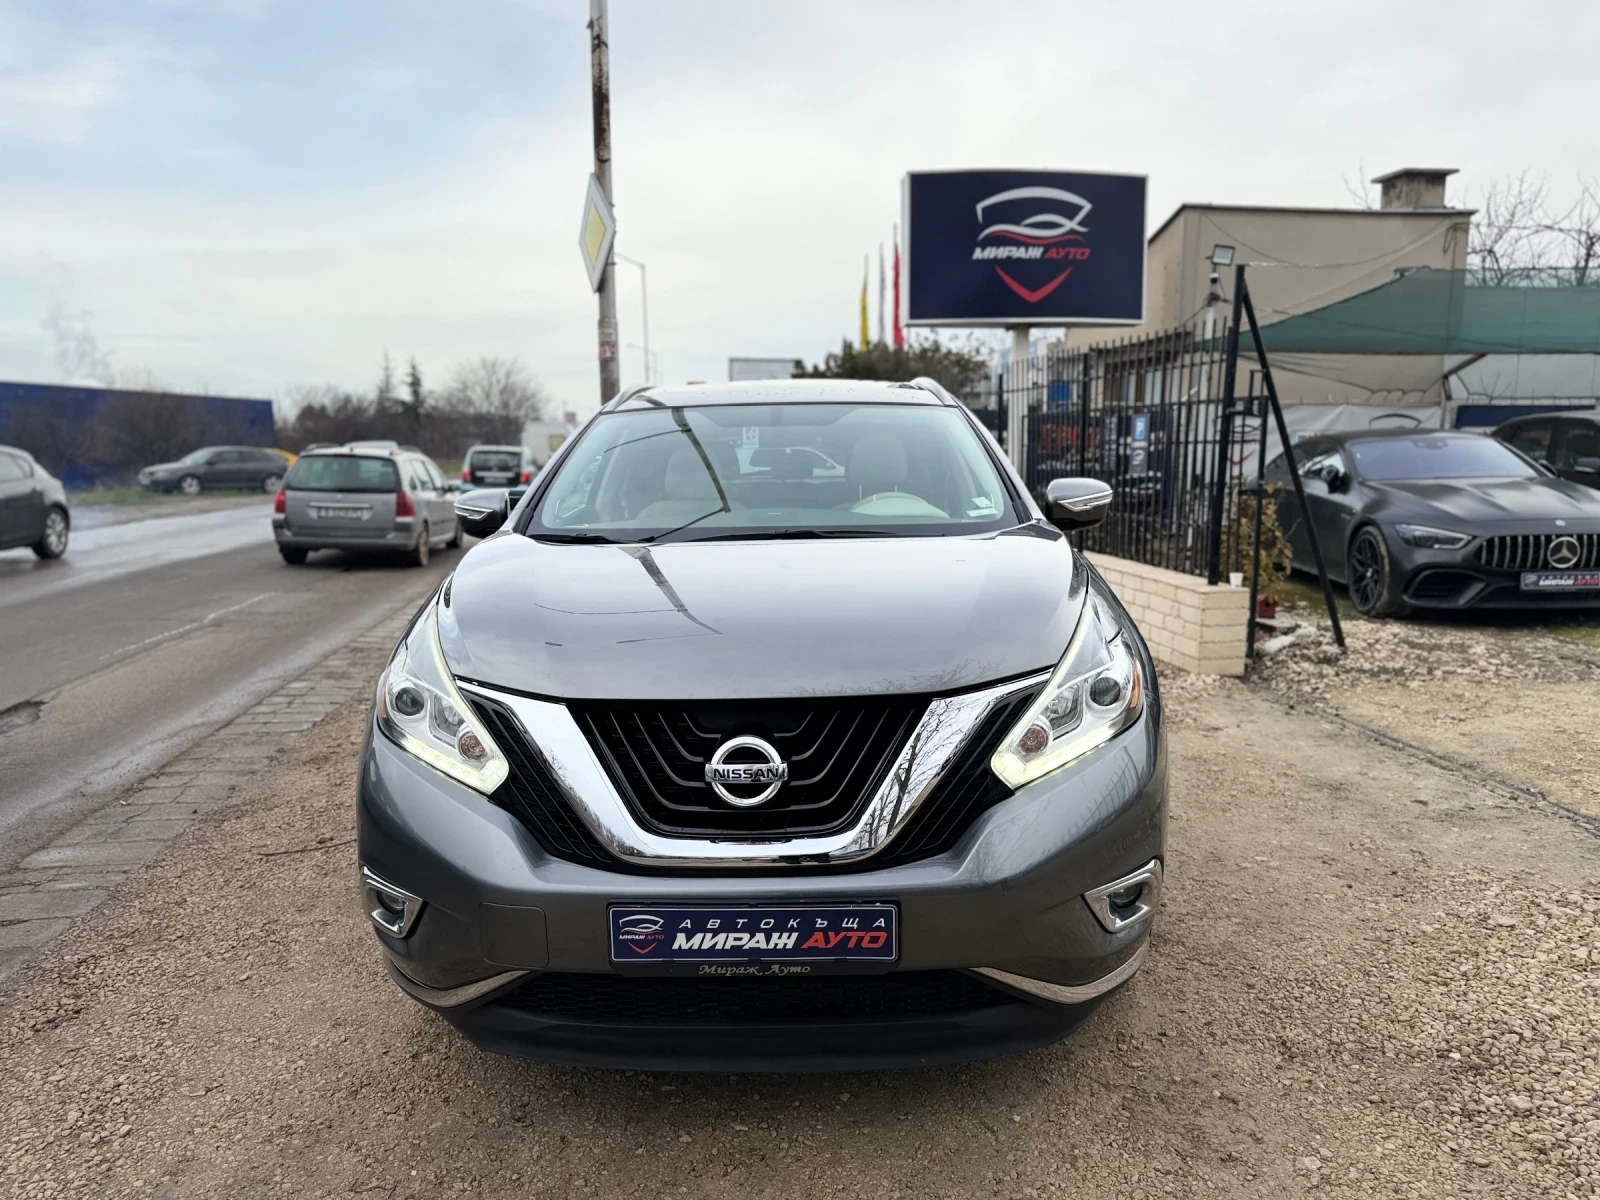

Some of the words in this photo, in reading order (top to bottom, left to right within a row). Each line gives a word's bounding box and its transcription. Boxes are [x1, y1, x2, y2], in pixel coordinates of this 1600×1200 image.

[972, 246, 1044, 260] МИРАЖ
[1044, 247, 1091, 260] АУТО
[713, 768, 779, 779] NISSAN
[672, 932, 800, 950] МИРАЖ
[800, 931, 888, 949] АУТО
[698, 964, 763, 977] Мираж
[764, 964, 811, 976] Ауто
